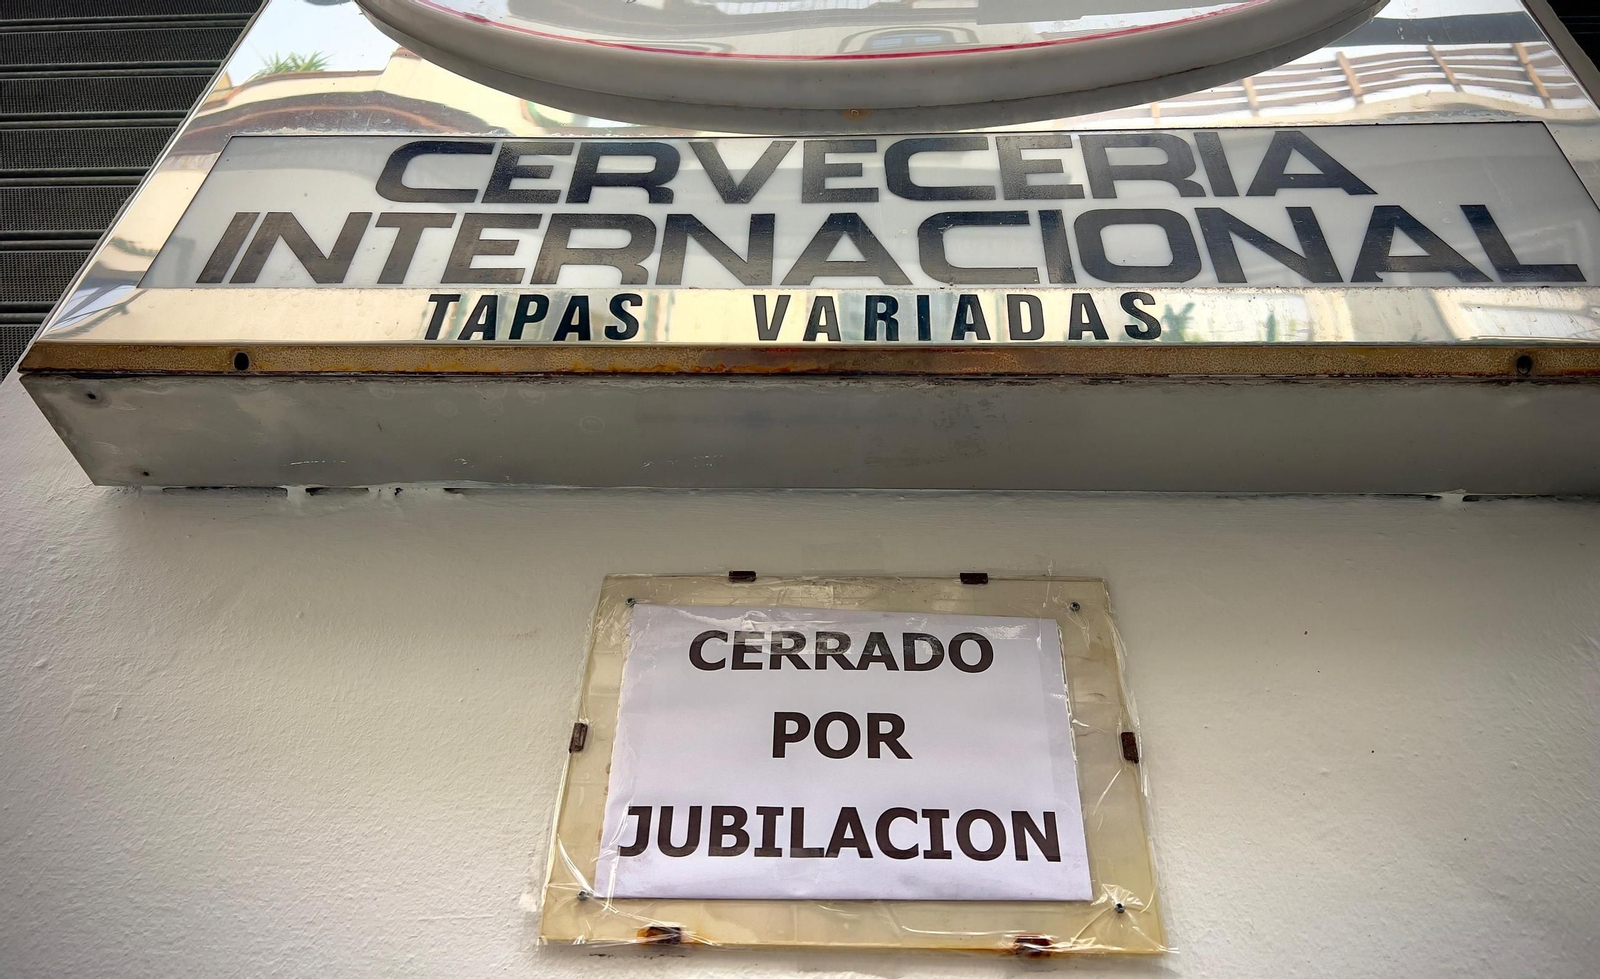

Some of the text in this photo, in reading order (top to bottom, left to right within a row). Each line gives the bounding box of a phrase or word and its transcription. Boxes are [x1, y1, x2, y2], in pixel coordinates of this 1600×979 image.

[375, 130, 1378, 204] CERVECERIA
[196, 204, 1587, 286] INTERNACIONAL
[424, 291, 1163, 342] TAPAS VARIADAS
[688, 630, 994, 673] CERRADO
[772, 711, 913, 760] POR
[617, 805, 1062, 862] JUBILACION
